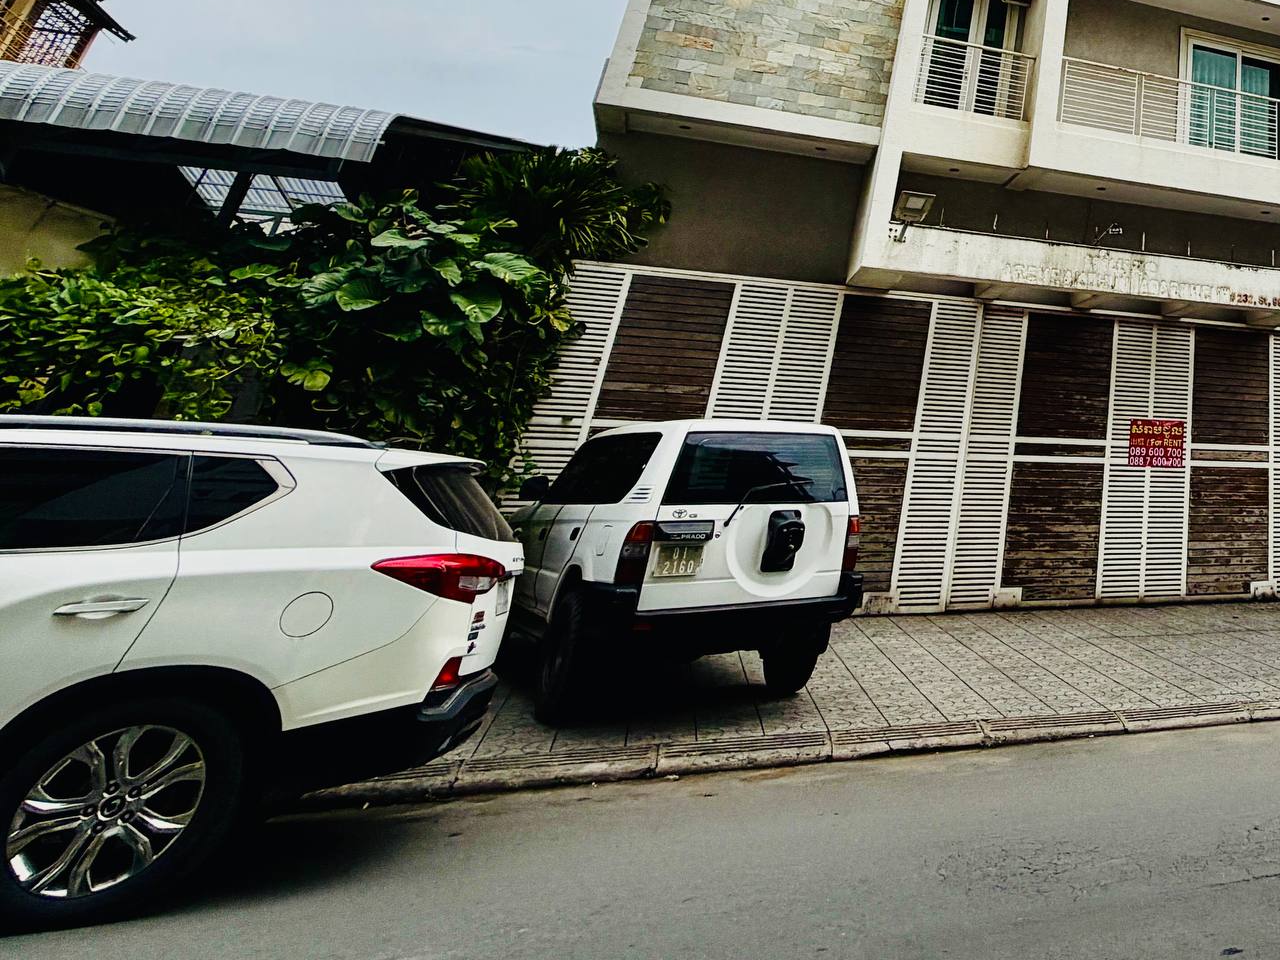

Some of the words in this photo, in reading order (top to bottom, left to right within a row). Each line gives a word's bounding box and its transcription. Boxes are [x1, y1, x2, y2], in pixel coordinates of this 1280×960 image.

[1163, 439, 1182, 447] RENT
[1130, 446, 1146, 456] 089
[1148, 447, 1164, 456] 600
[1166, 447, 1182, 458] 700
[1129, 456, 1144, 466] 088
[1145, 456, 1151, 466] 7
[1152, 456, 1167, 467] 600
[1167, 457, 1182, 467] 700
[662, 560, 694, 574] 2160
